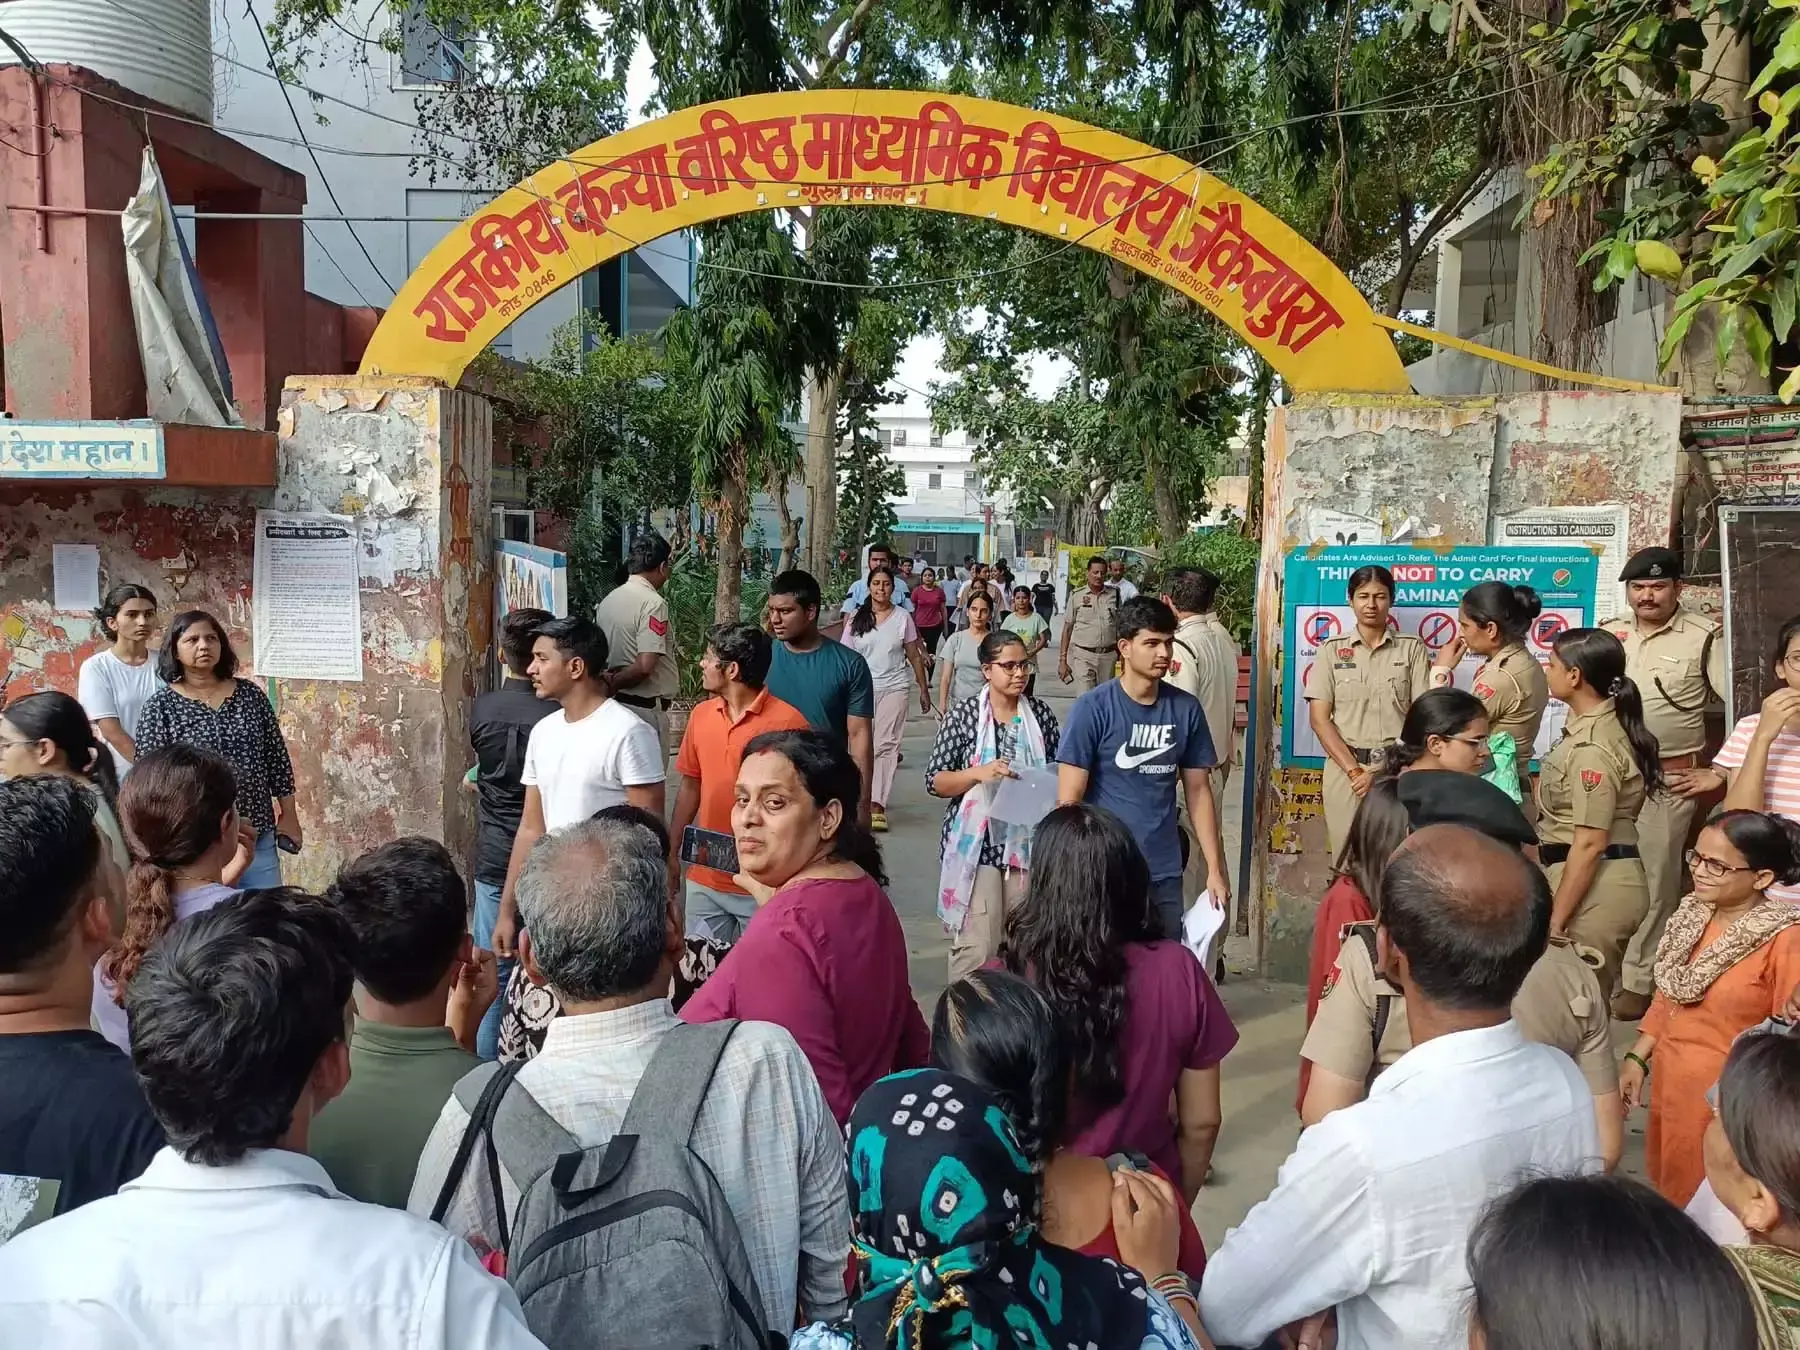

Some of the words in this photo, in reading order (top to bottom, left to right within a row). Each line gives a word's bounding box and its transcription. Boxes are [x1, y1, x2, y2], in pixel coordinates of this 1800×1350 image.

[413, 197, 568, 343] राजकीय
[555, 144, 678, 237] कन्या
[674, 109, 799, 195] वरिष्ठ
[802, 102, 1009, 194] माध्यमिक
[1008, 121, 1192, 249] विद्यालय
[8, 430, 55, 470] देश
[60, 440, 134, 470] महान
[1507, 524, 1557, 535] INSTRUCTIONS
[1559, 524, 1569, 535] TO
[1569, 524, 1614, 535] CANDIDATES
[1342, 554, 1358, 562] Are
[1360, 554, 1394, 562] Advised
[1396, 554, 1407, 562] To
[1409, 554, 1431, 562] Refer
[1433, 554, 1450, 562] The
[1451, 554, 1477, 562] Admit
[1478, 554, 1499, 562] Card
[1501, 555, 1516, 563] For
[1517, 555, 1538, 563] Final
[1539, 555, 1590, 563] Instructions
[1393, 567, 1434, 581] NOT
[1438, 567, 1464, 581] TO
[1469, 568, 1534, 582] CARRY
[1129, 723, 1173, 749] NIKE
